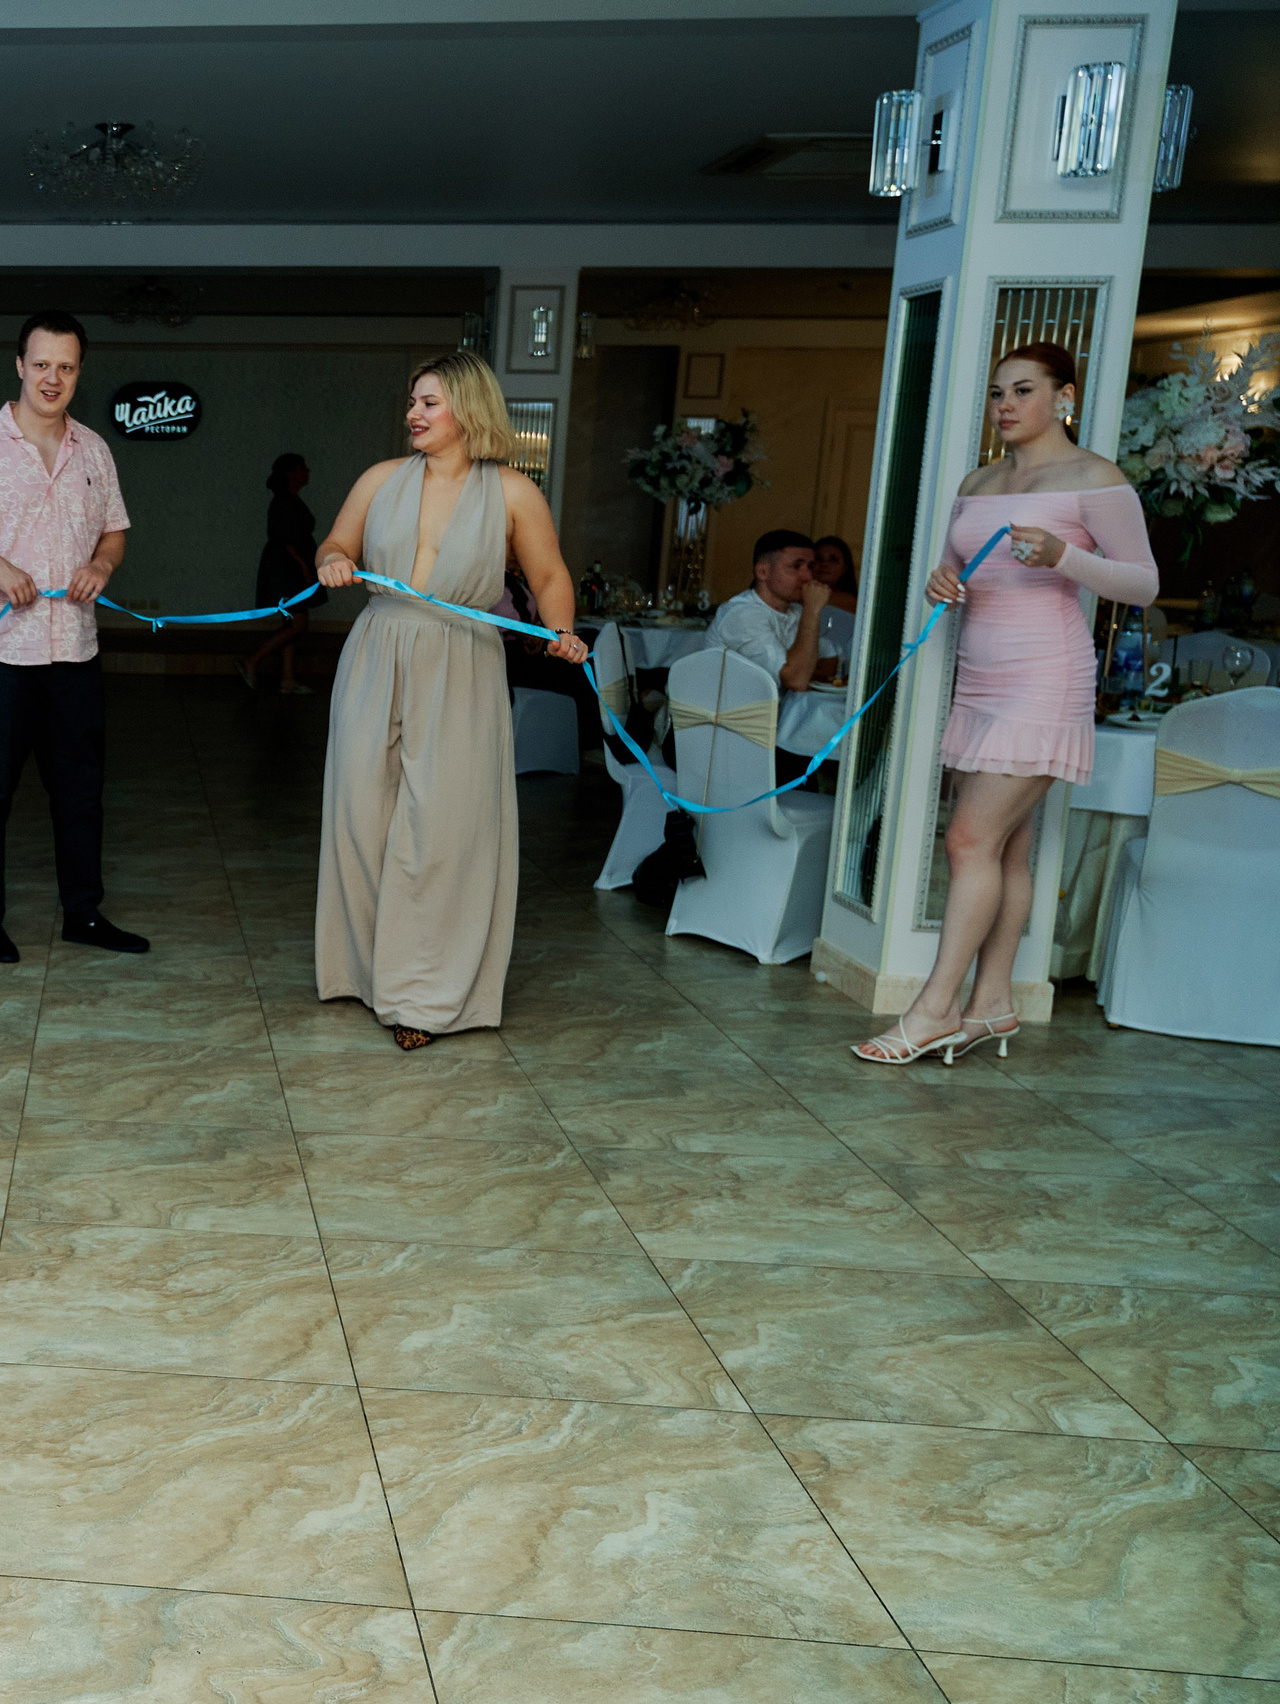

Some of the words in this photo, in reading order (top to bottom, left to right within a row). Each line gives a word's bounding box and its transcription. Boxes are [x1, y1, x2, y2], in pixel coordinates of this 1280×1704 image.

[115, 390, 197, 428] Чайка
[144, 425, 188, 434] РЕСТОРАН
[698, 590, 710, 612] 3
[1145, 662, 1171, 697] 2
